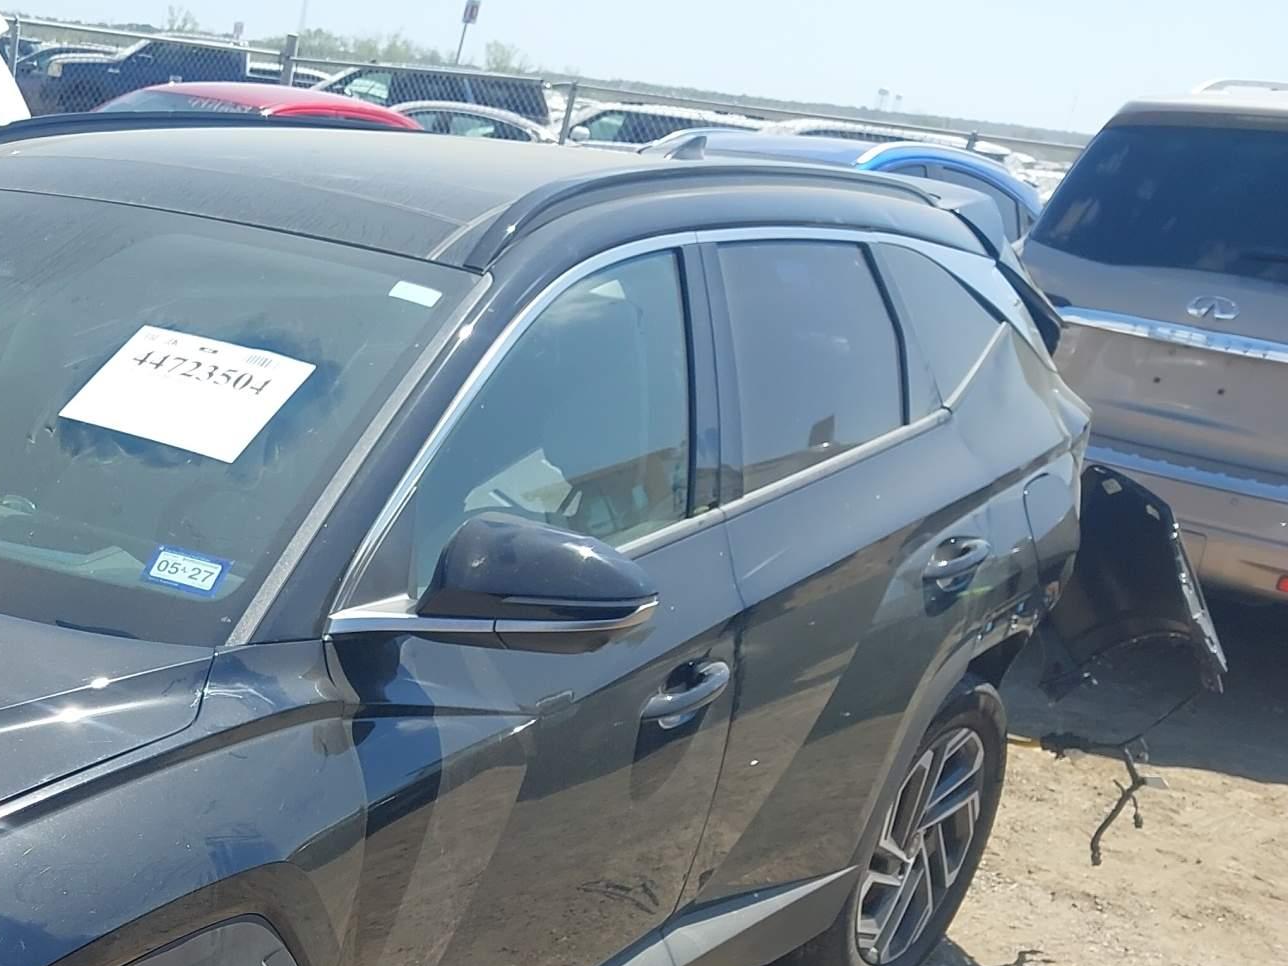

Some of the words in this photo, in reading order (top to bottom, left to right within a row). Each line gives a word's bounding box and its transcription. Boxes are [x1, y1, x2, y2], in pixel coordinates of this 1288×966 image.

[132, 350, 272, 395] 44723504
[157, 560, 181, 575] 05
[187, 567, 214, 583] 27
